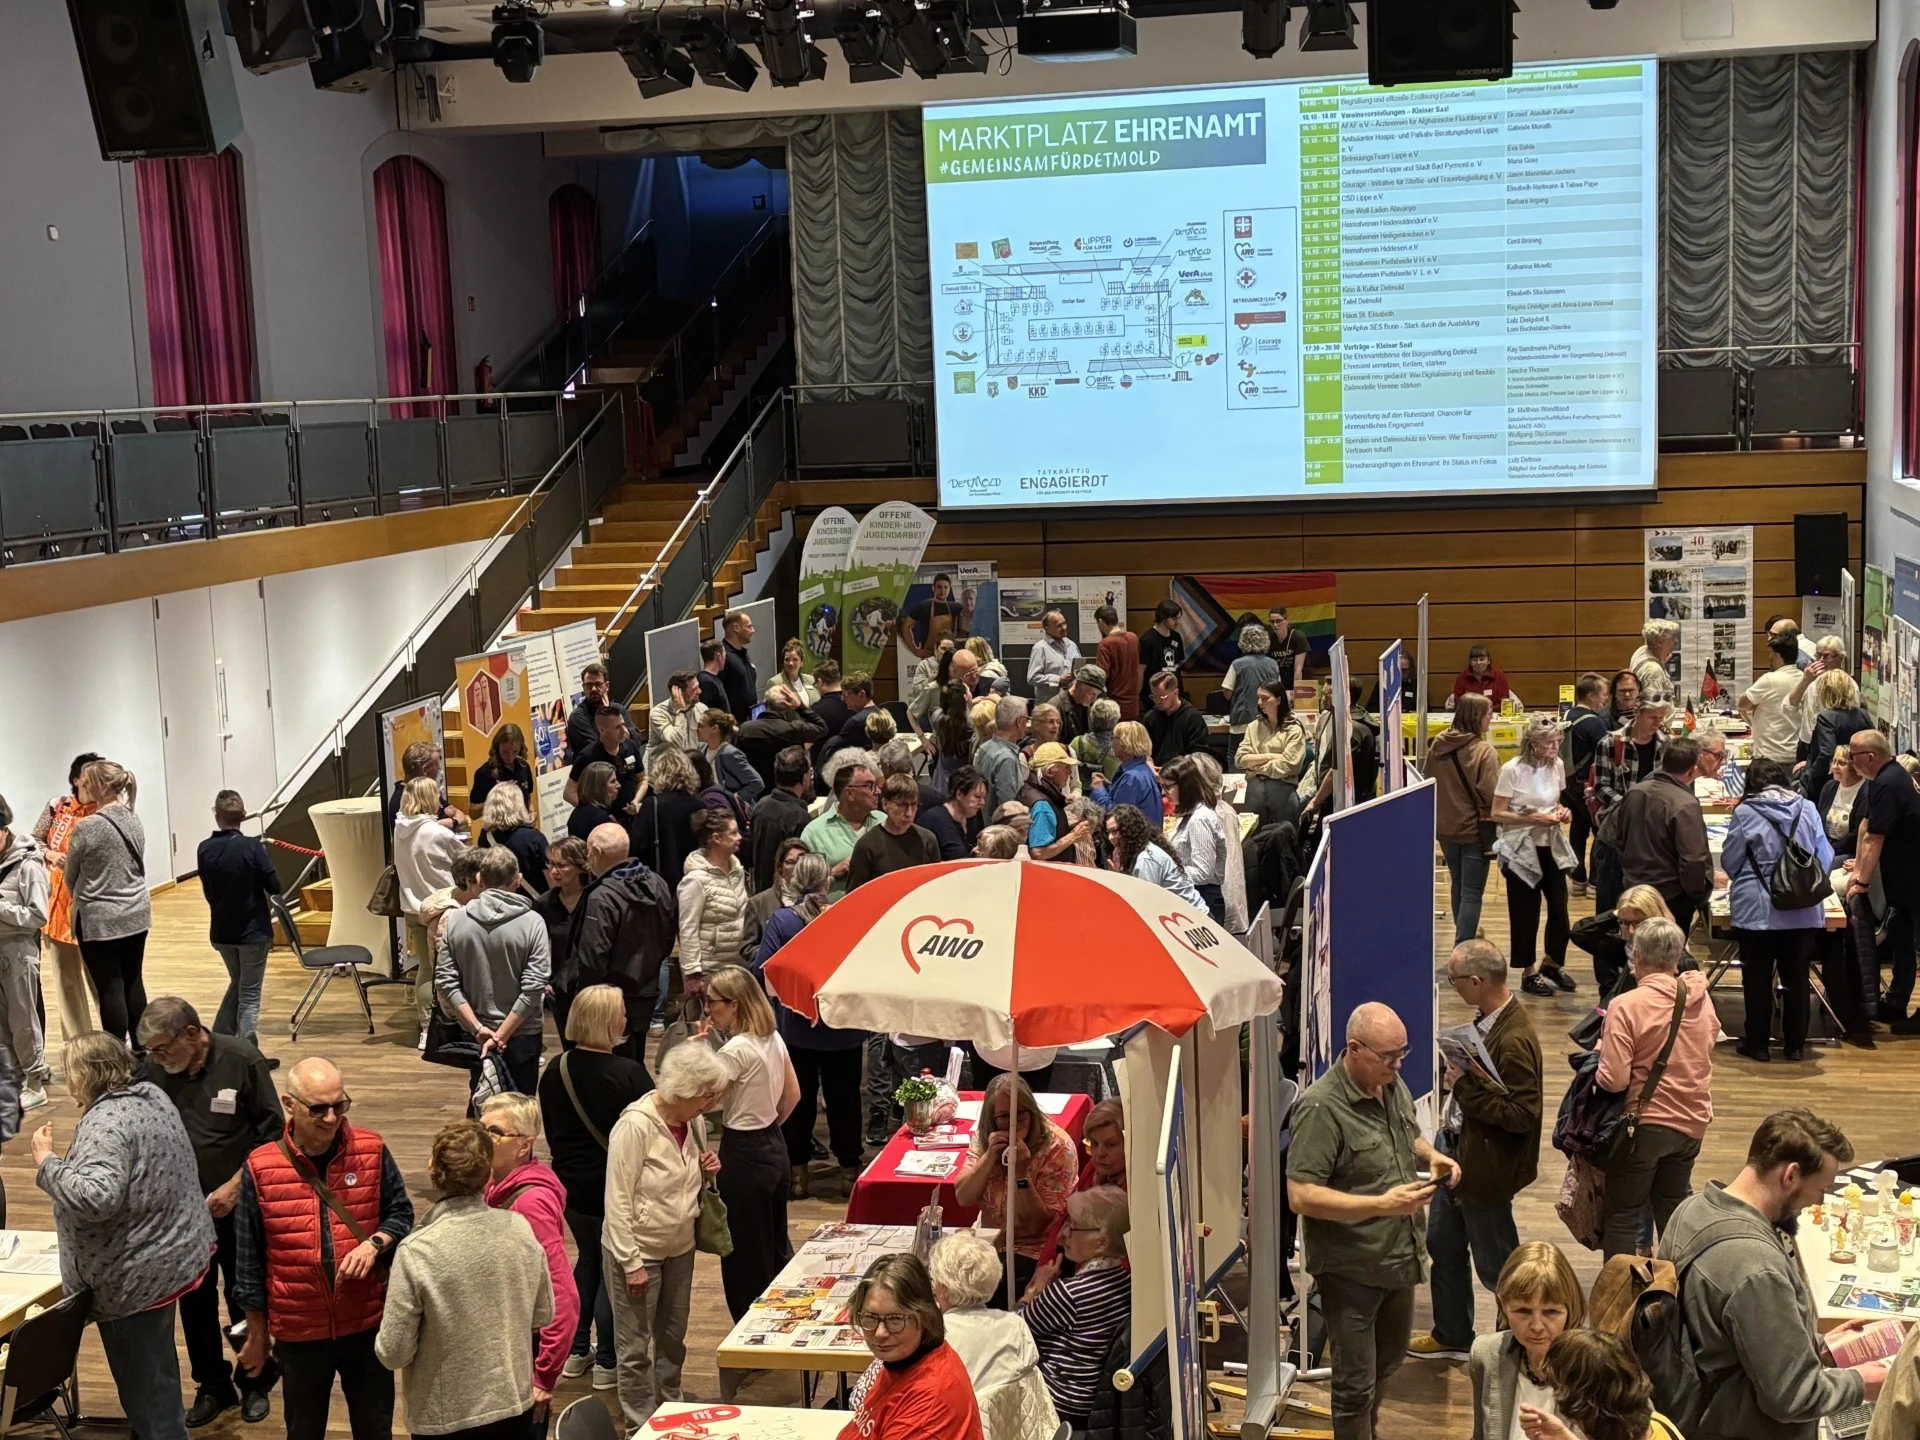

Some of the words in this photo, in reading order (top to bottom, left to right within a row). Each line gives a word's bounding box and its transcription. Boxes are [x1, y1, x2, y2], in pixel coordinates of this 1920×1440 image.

[939, 120, 1107, 152] MARKTPLATZ
[1115, 113, 1261, 143] EHRENAMT
[940, 150, 1161, 176] #GEMEINSAMFÜRDETMOLD
[1083, 236, 1112, 244] LIPPER
[1179, 270, 1199, 278] VerA
[1344, 342, 1369, 350] Vorträge
[1029, 386, 1046, 396] KKD
[1388, 421, 1424, 429] Engagement
[1020, 475, 1108, 489] ENGAGIERDT
[879, 511, 911, 519] OFFENE
[823, 517, 845, 525] OFFENE
[864, 531, 925, 539] JUGENDARBEIT
[1691, 536, 1704, 546] 40
[1187, 927, 1219, 951] AWO
[918, 935, 984, 960] AWO
